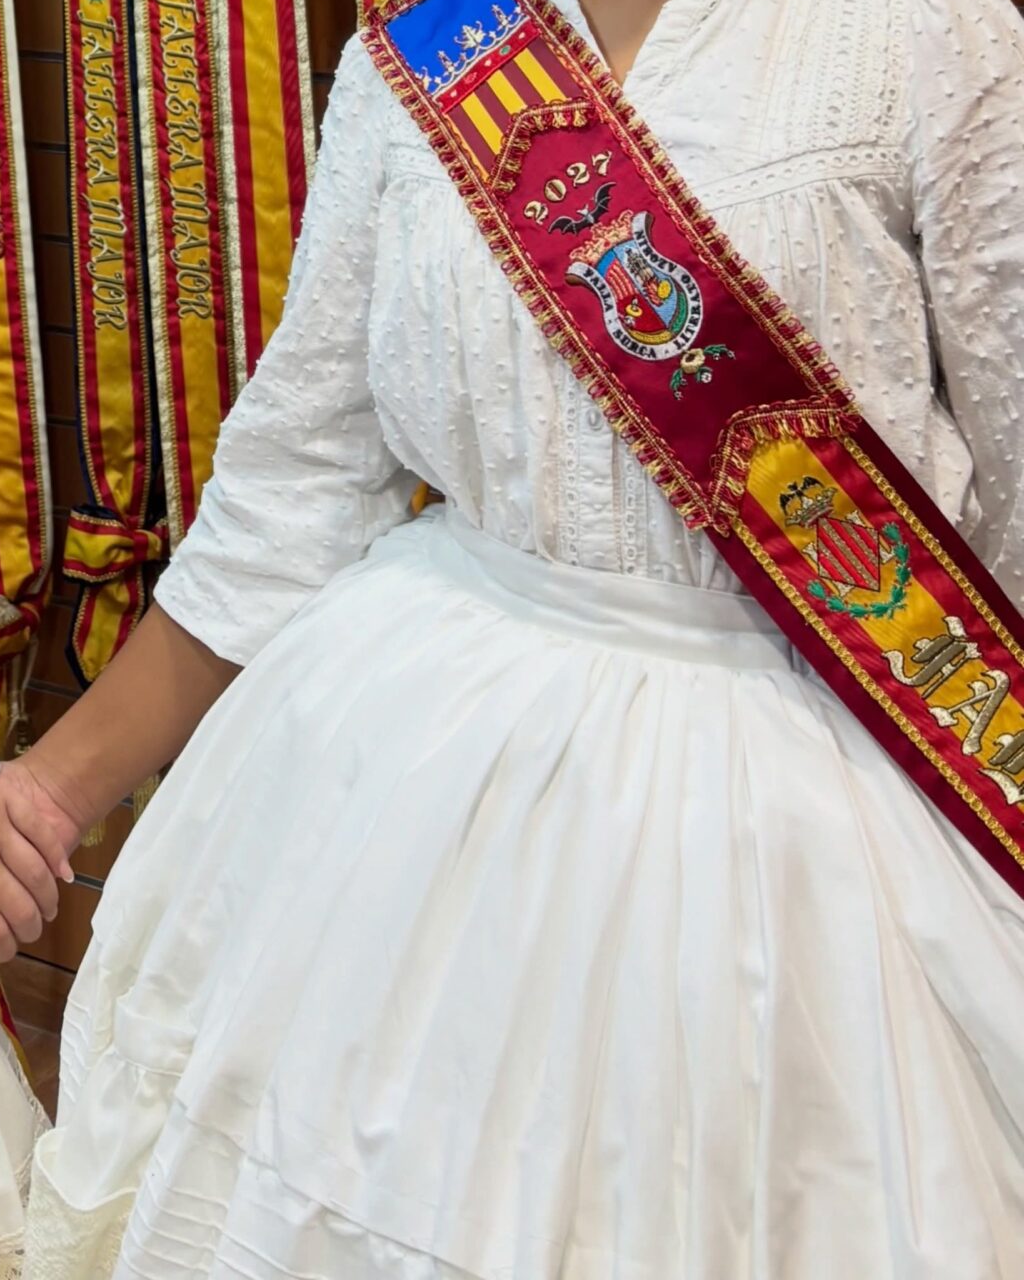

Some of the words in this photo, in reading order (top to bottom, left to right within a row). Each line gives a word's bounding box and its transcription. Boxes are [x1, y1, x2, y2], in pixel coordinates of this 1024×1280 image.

[77, 9, 120, 187] FALLERA
[164, 177, 214, 320] MAJOR
[524, 150, 613, 224] 2027
[83, 192, 127, 331] MAJOR
